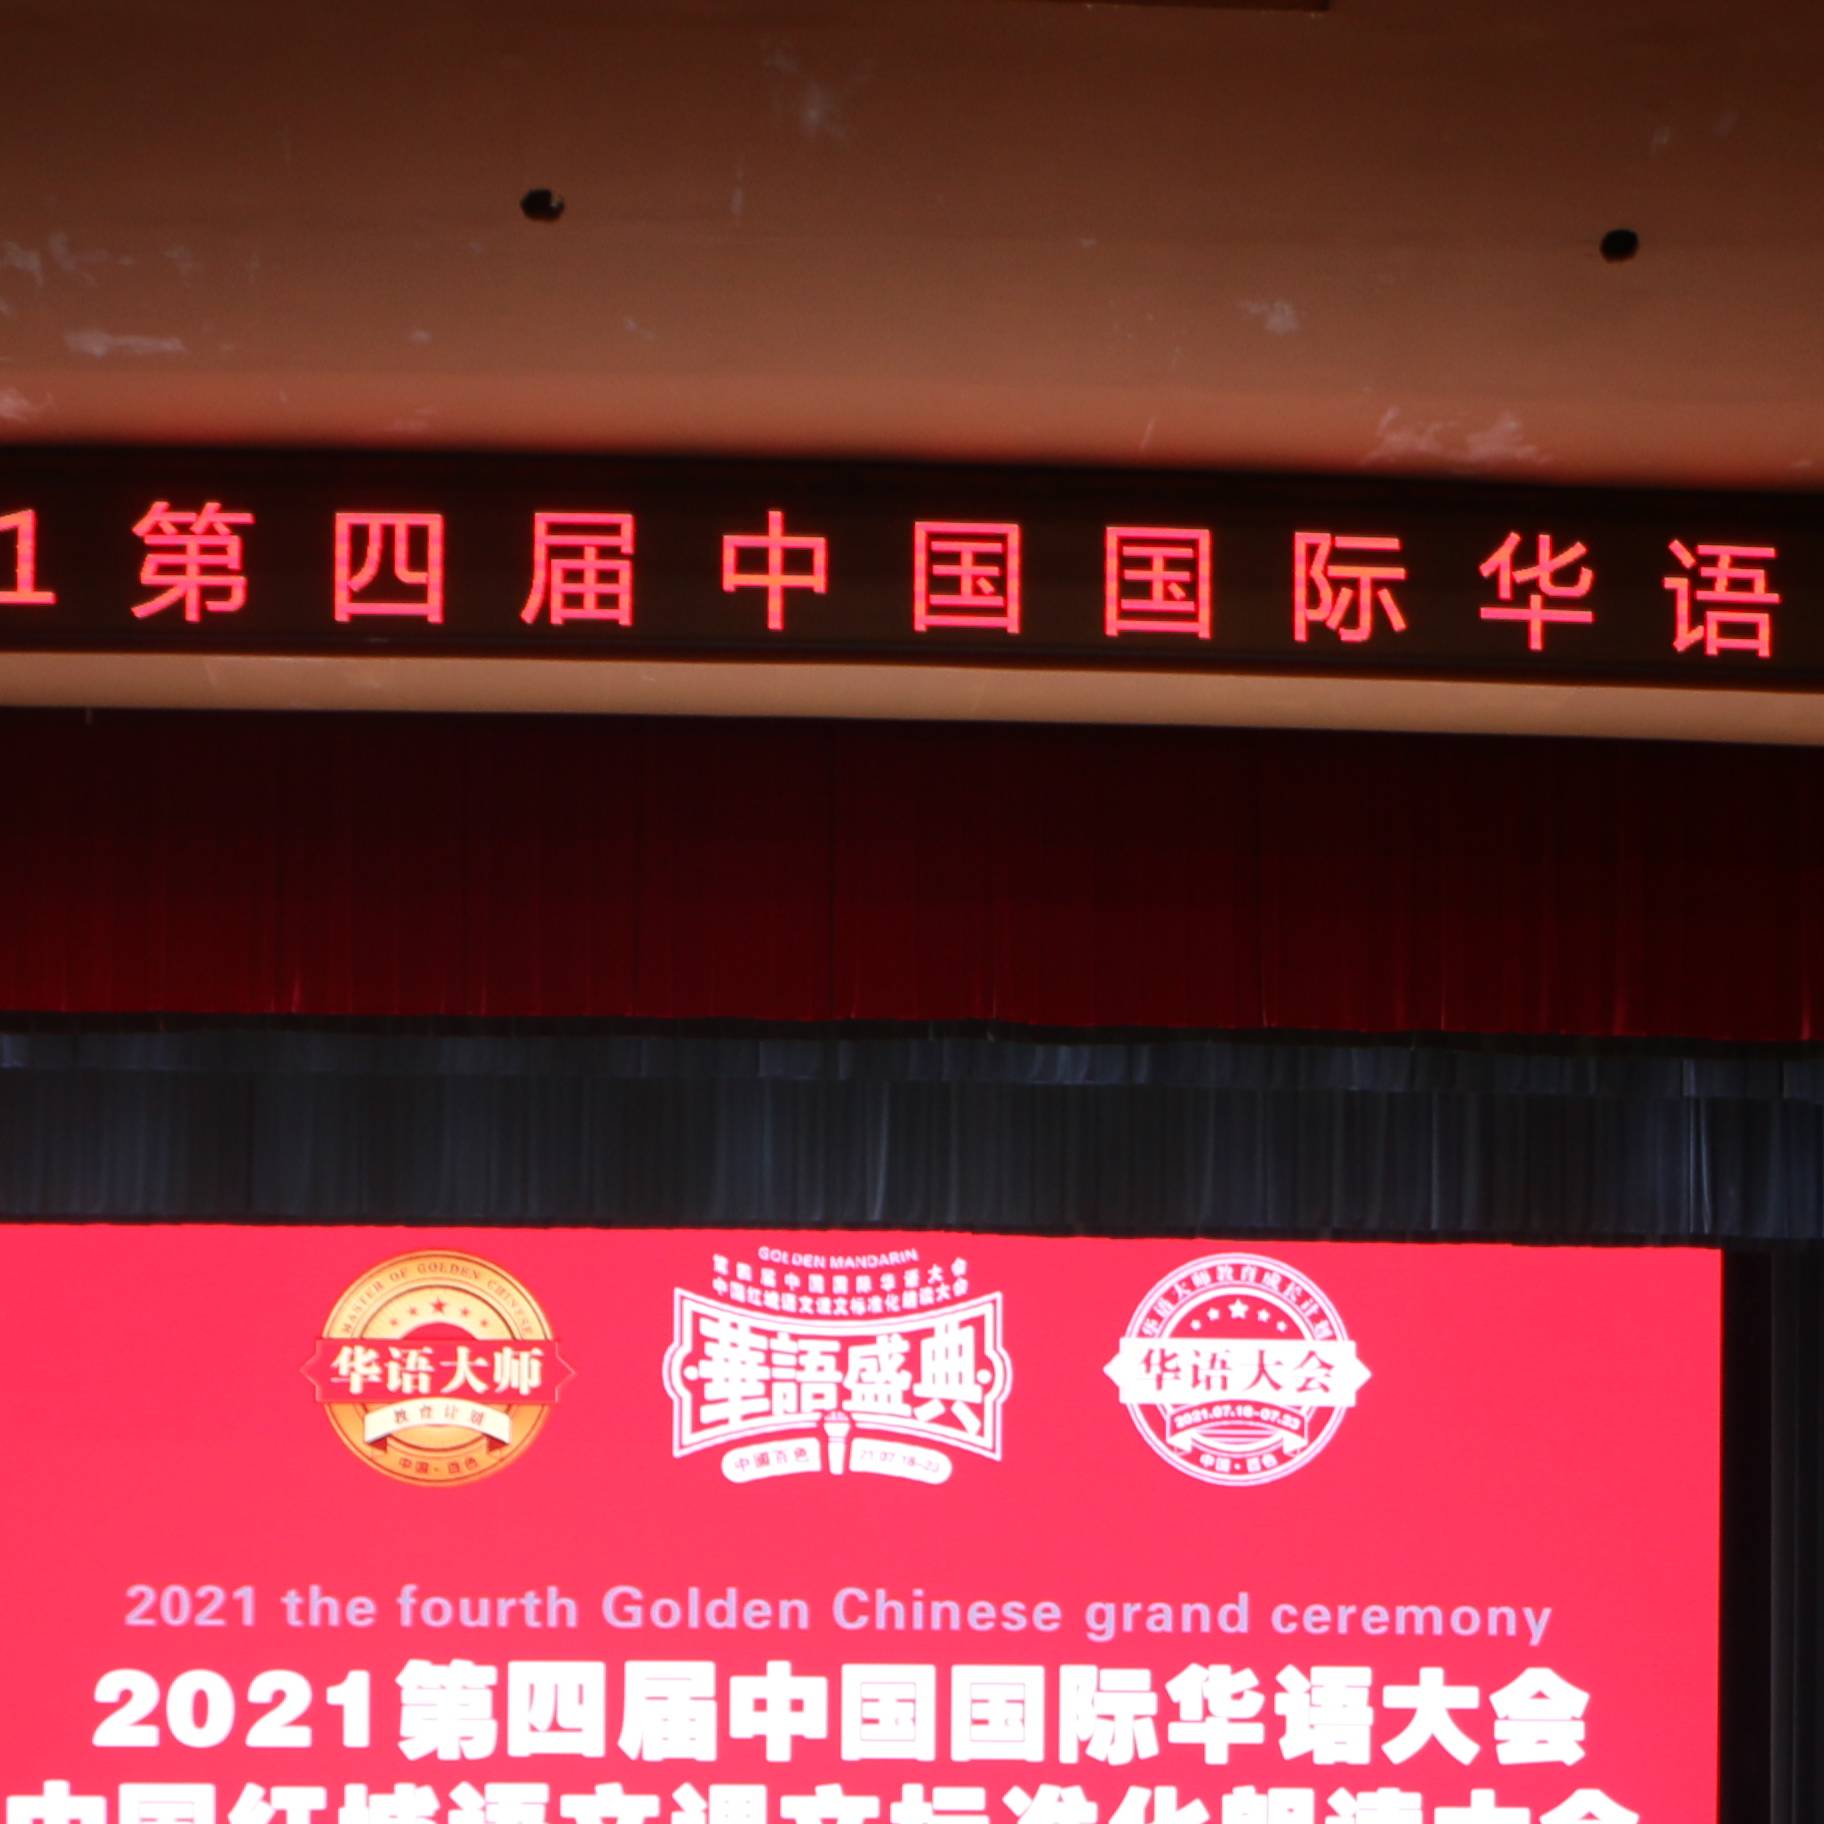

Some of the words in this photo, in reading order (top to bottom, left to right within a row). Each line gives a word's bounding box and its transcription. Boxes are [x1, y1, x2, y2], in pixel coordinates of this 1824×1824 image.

[757, 1245, 826, 1269] GOLDEN
[828, 1248, 919, 1270] MANDARIN
[341, 1280, 385, 1334] MASTER
[389, 1269, 409, 1281] OF
[417, 1261, 481, 1281] GOLDEN
[487, 1279, 534, 1336] CHINESE
[330, 1344, 545, 1396] 华语大师
[698, 1319, 983, 1436] 華語盛典
[1137, 1346, 1336, 1394] 华语大会
[125, 1584, 255, 1626] 2021
[280, 1584, 377, 1627] the
[396, 1583, 577, 1628] fourth
[602, 1584, 810, 1630] Golden
[832, 1586, 1062, 1632] Chinese
[1085, 1591, 1249, 1643] grand
[1271, 1596, 1552, 1646] ceremony
